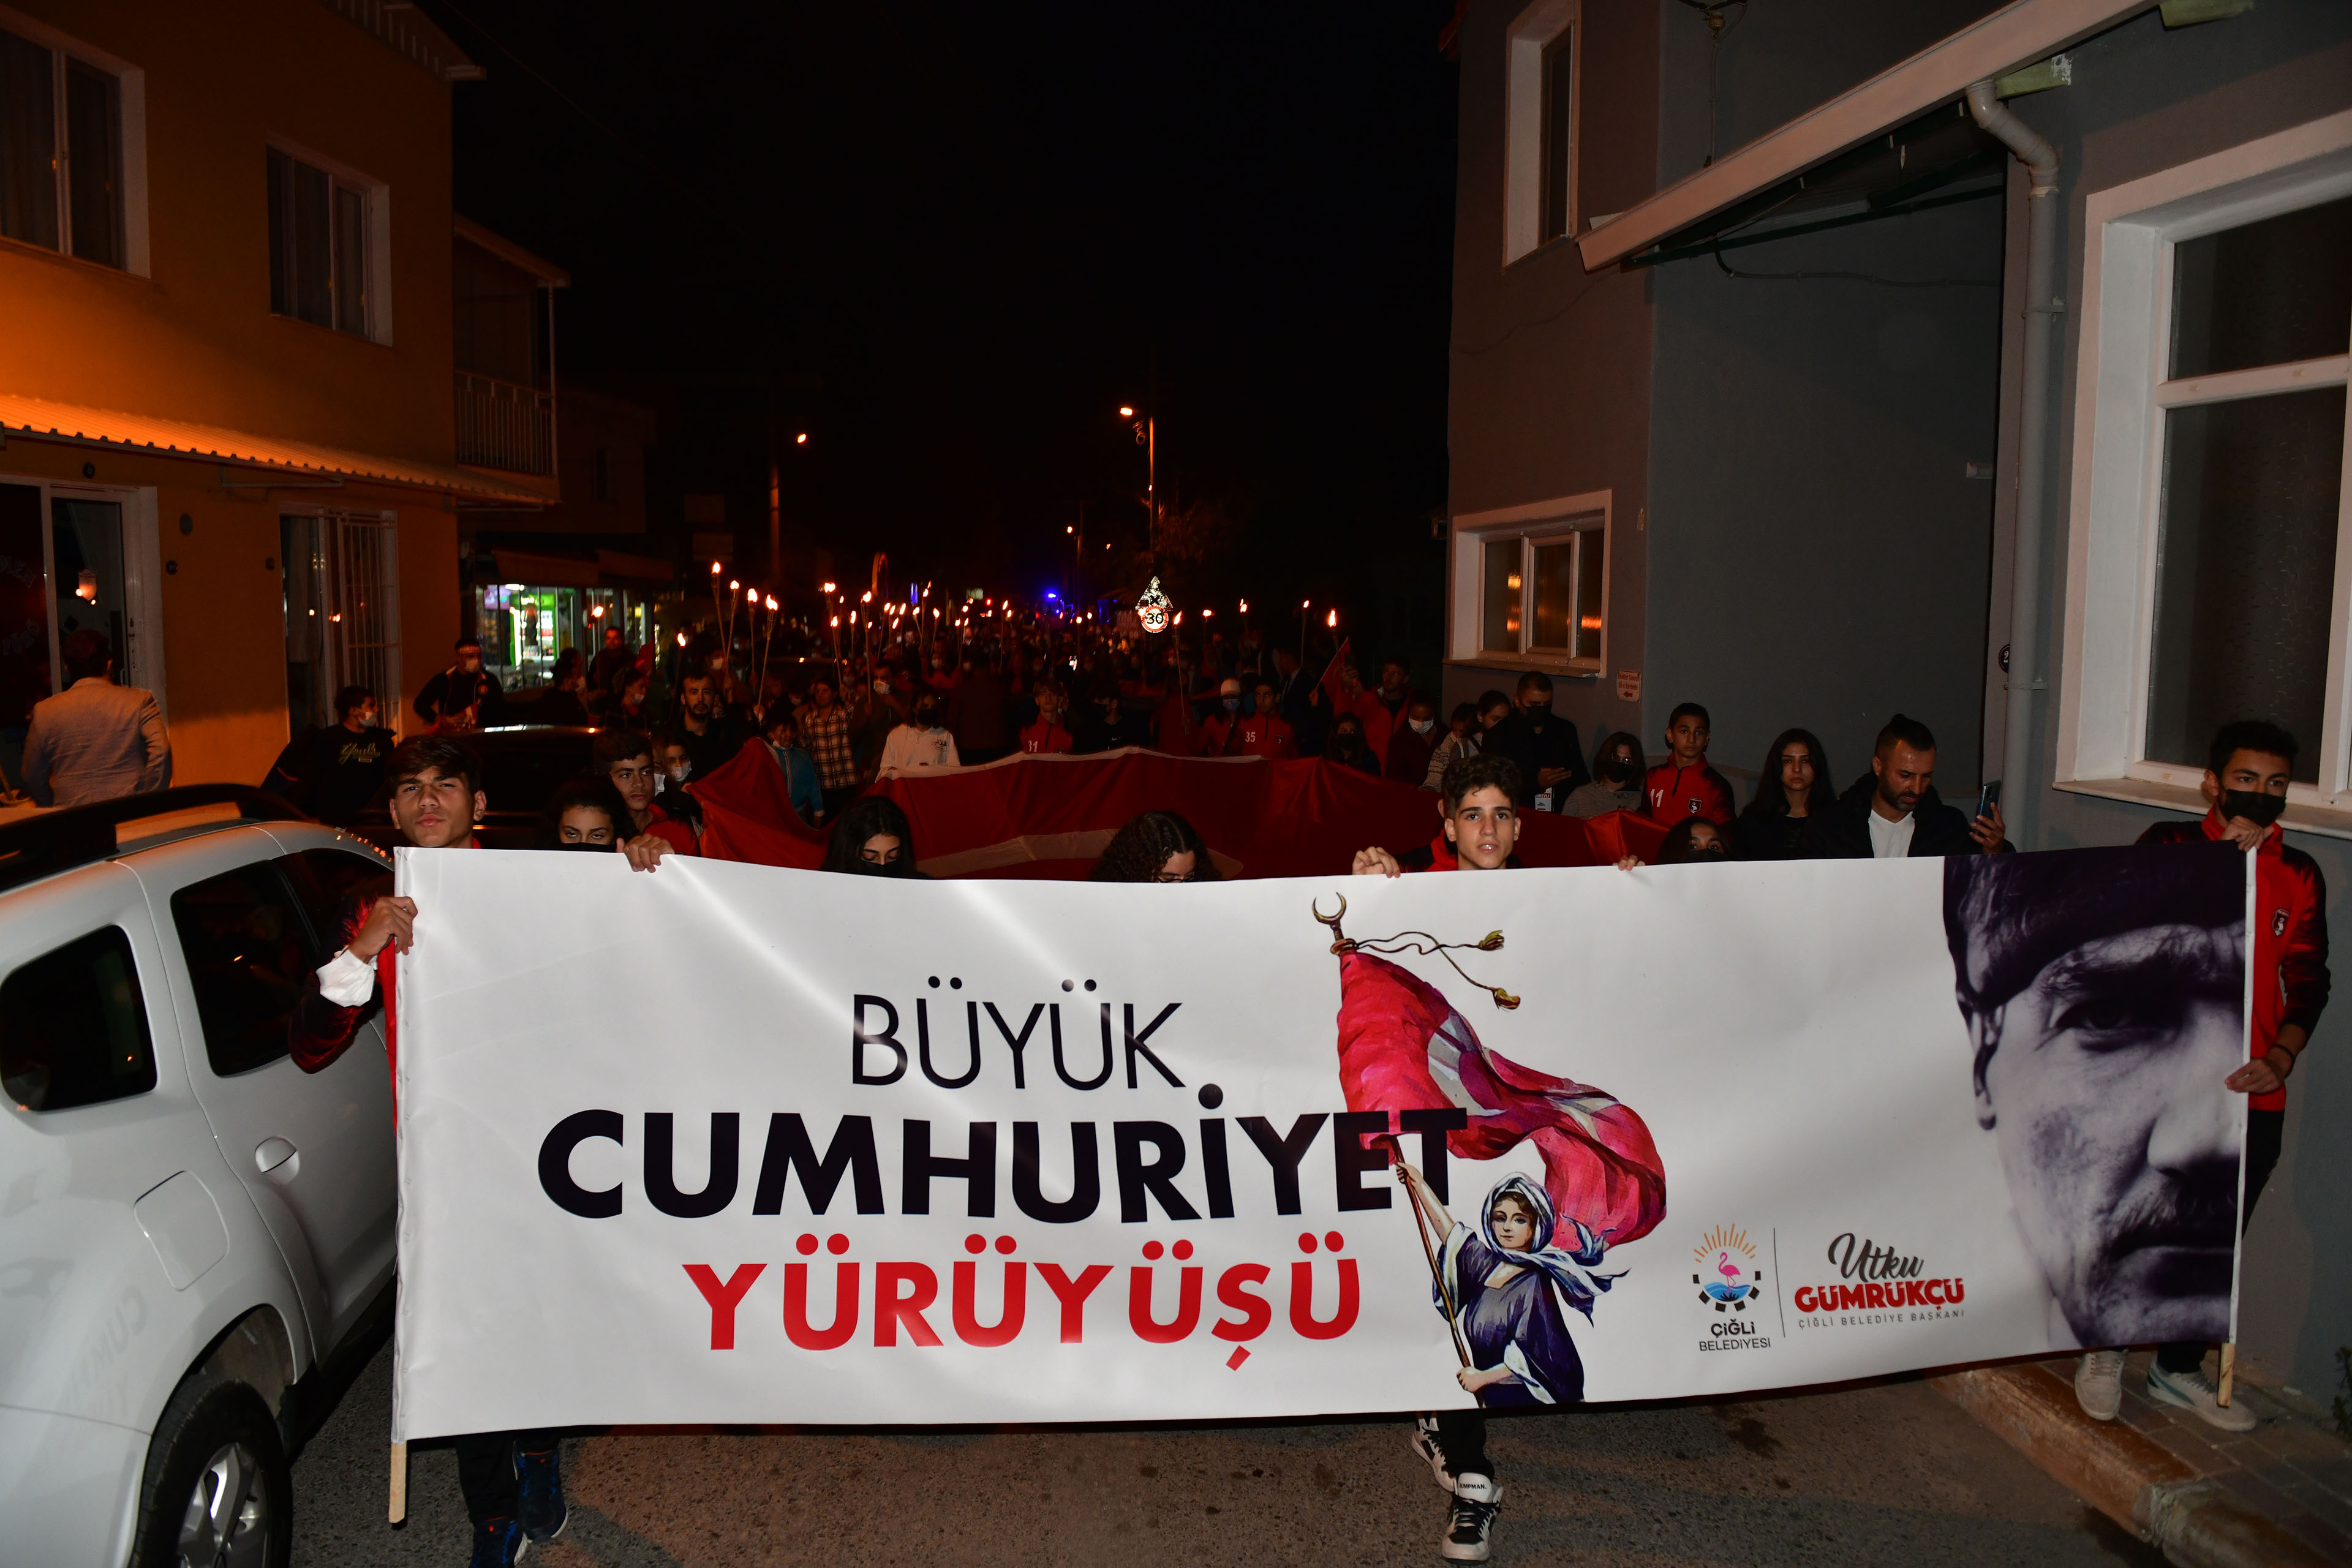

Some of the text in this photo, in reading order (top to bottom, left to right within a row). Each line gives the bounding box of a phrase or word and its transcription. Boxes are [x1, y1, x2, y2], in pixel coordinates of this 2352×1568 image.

[1147, 612, 1164, 624] 30
[1245, 731, 1256, 742] 35
[1649, 788, 1664, 808] 11
[852, 976, 1187, 1090] BÜYÜK
[537, 1083, 1468, 1224] CUMHURİYET
[1828, 1232, 1924, 1283] Utku
[682, 1231, 1361, 1371] YÜRÜYÜŞÜ
[1794, 1278, 1965, 1312] GÜMRÜKÇÜ
[1711, 1319, 1755, 1338] ÇİĞLİ
[1911, 1310, 1965, 1322] BAŞKANI
